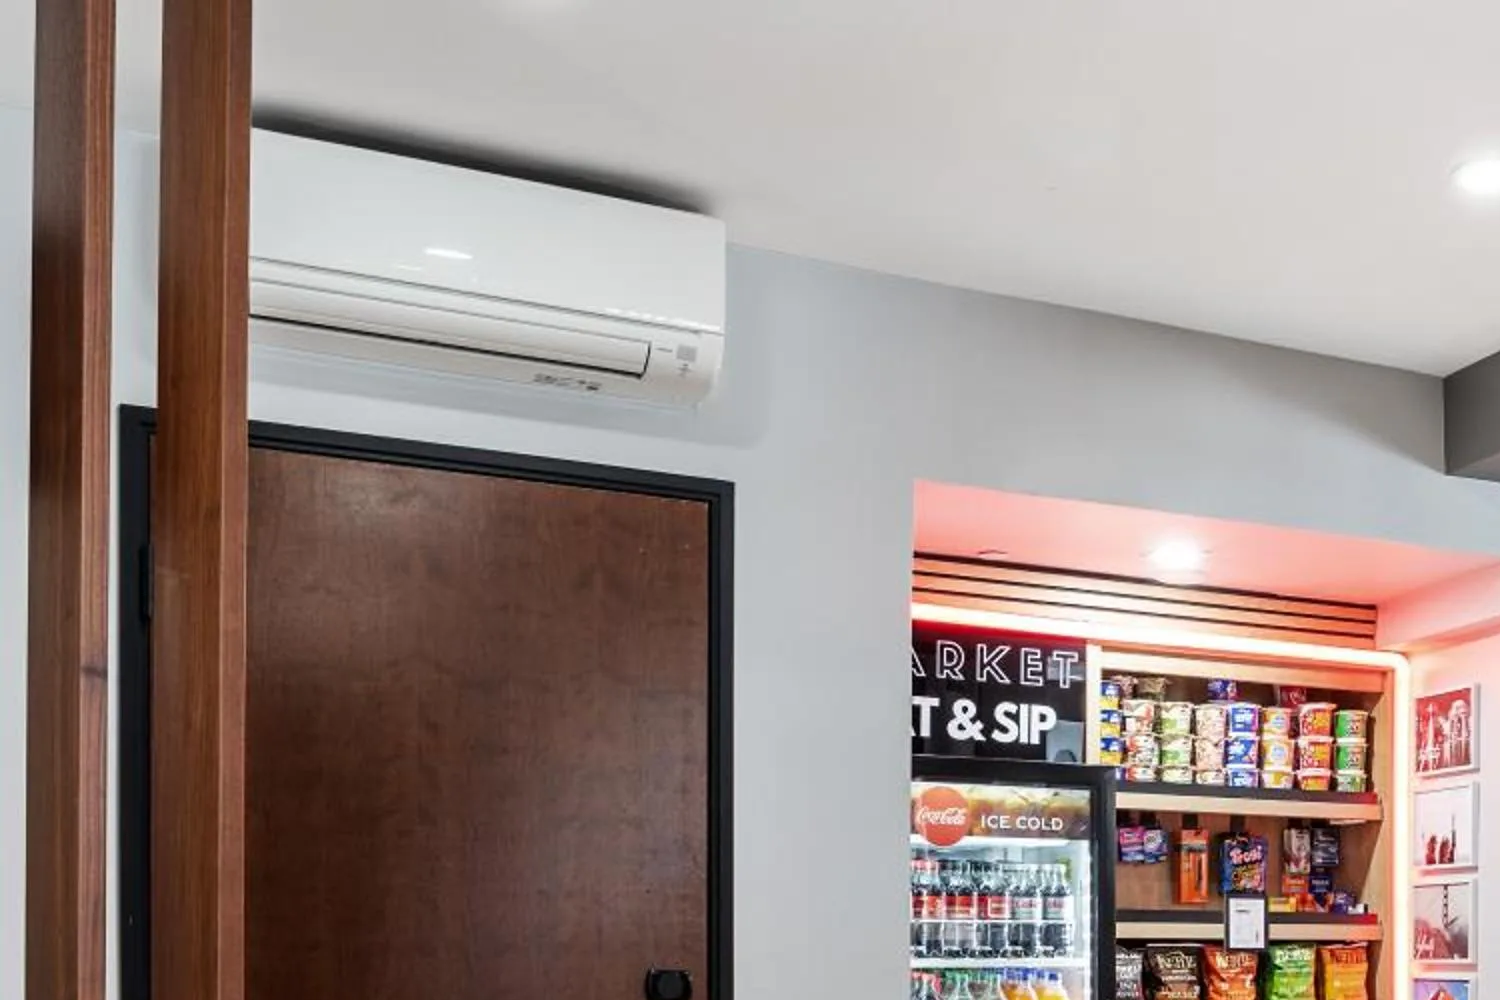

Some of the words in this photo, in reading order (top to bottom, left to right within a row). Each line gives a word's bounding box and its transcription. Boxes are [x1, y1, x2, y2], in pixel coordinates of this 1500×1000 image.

[912, 695, 940, 737] T
[946, 698, 987, 742] &
[991, 701, 1057, 745] SIP
[980, 814, 1012, 829] ICE
[1014, 815, 1064, 831] COLD
